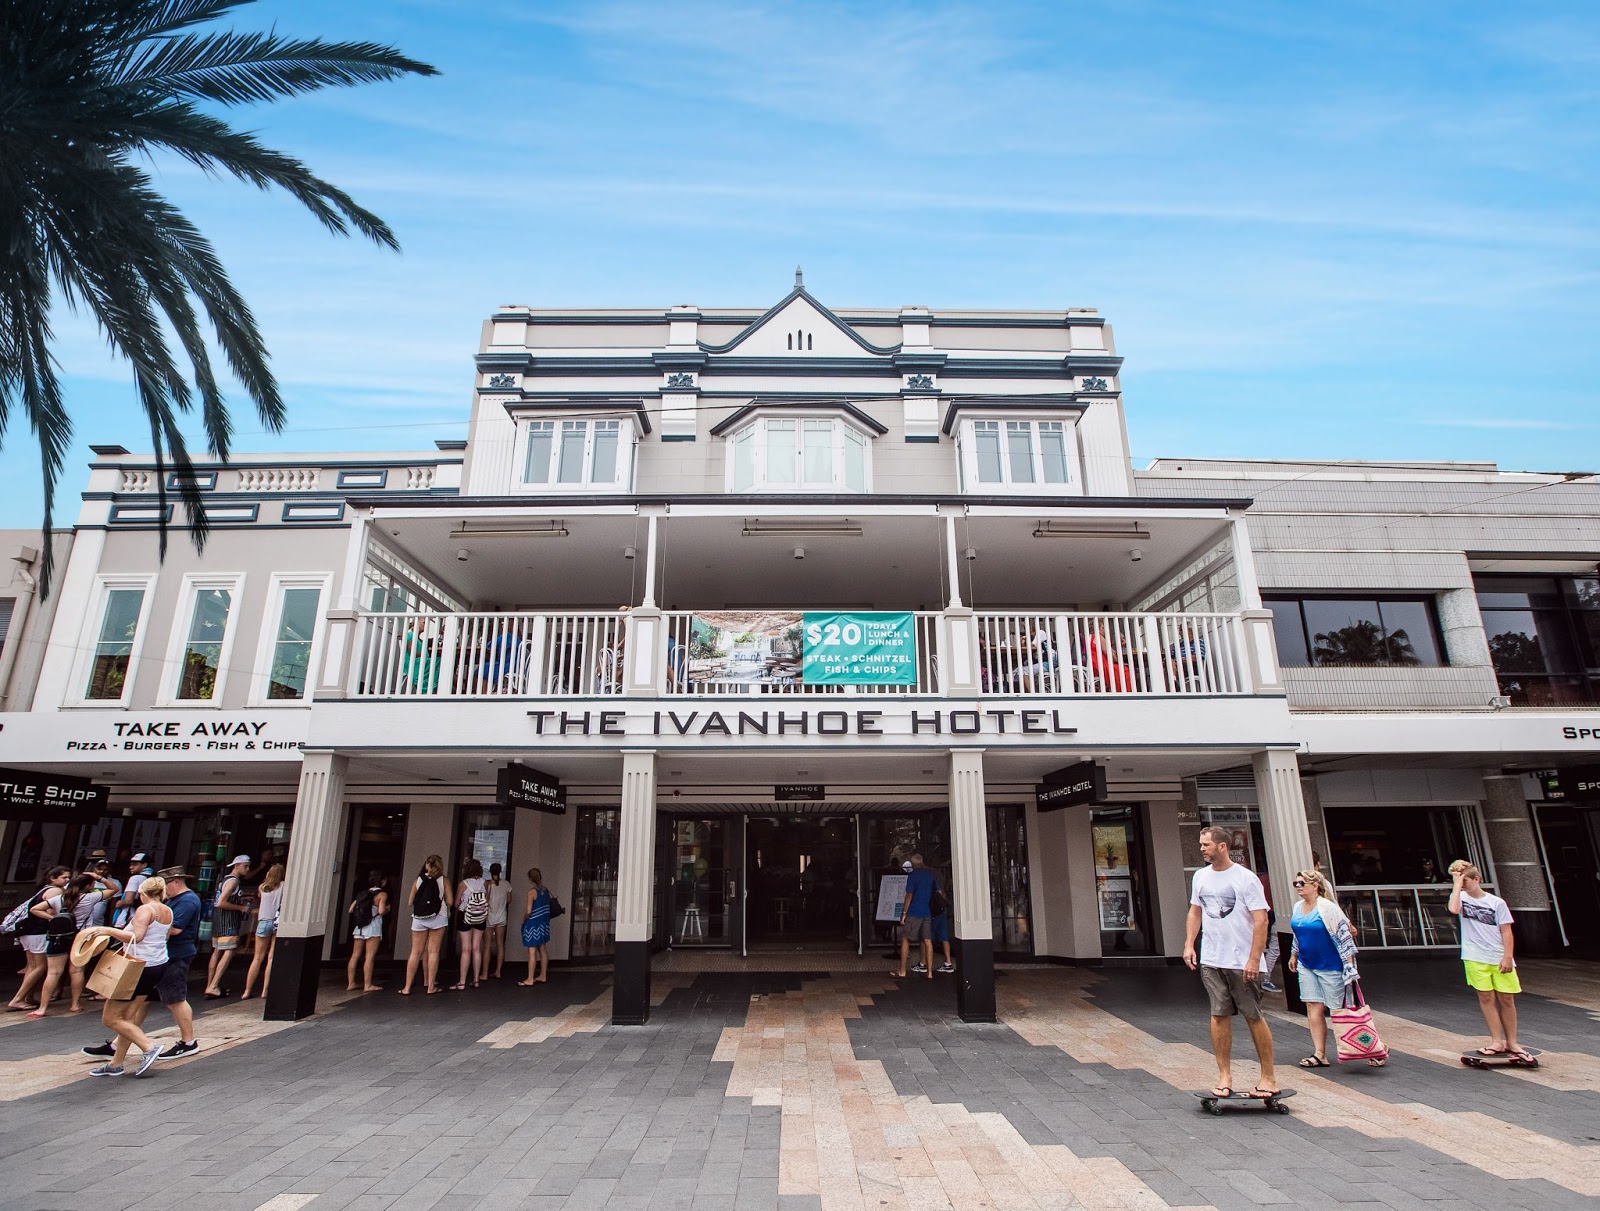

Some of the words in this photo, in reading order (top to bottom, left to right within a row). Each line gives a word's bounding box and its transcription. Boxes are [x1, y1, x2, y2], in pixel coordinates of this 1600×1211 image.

[807, 623, 861, 646] $20
[806, 655, 842, 663] STEAK
[851, 655, 912, 663] SCHNITZEL
[825, 666, 849, 674] FISH
[853, 666, 860, 674] &
[864, 666, 897, 674] CHIPS
[114, 722, 180, 736] TAKE
[191, 722, 267, 736] AWAY
[526, 711, 626, 735] THE
[653, 710, 883, 735] IVANHOE
[911, 709, 1078, 734] HOTEL
[245, 741, 256, 750] &
[45, 785, 97, 801] SHOP
[521, 779, 539, 794] TAKE
[540, 785, 558, 798] AWAY
[1039, 792, 1048, 801] THE
[1049, 786, 1071, 799] IVANHOE
[1072, 780, 1092, 793] HOTEL
